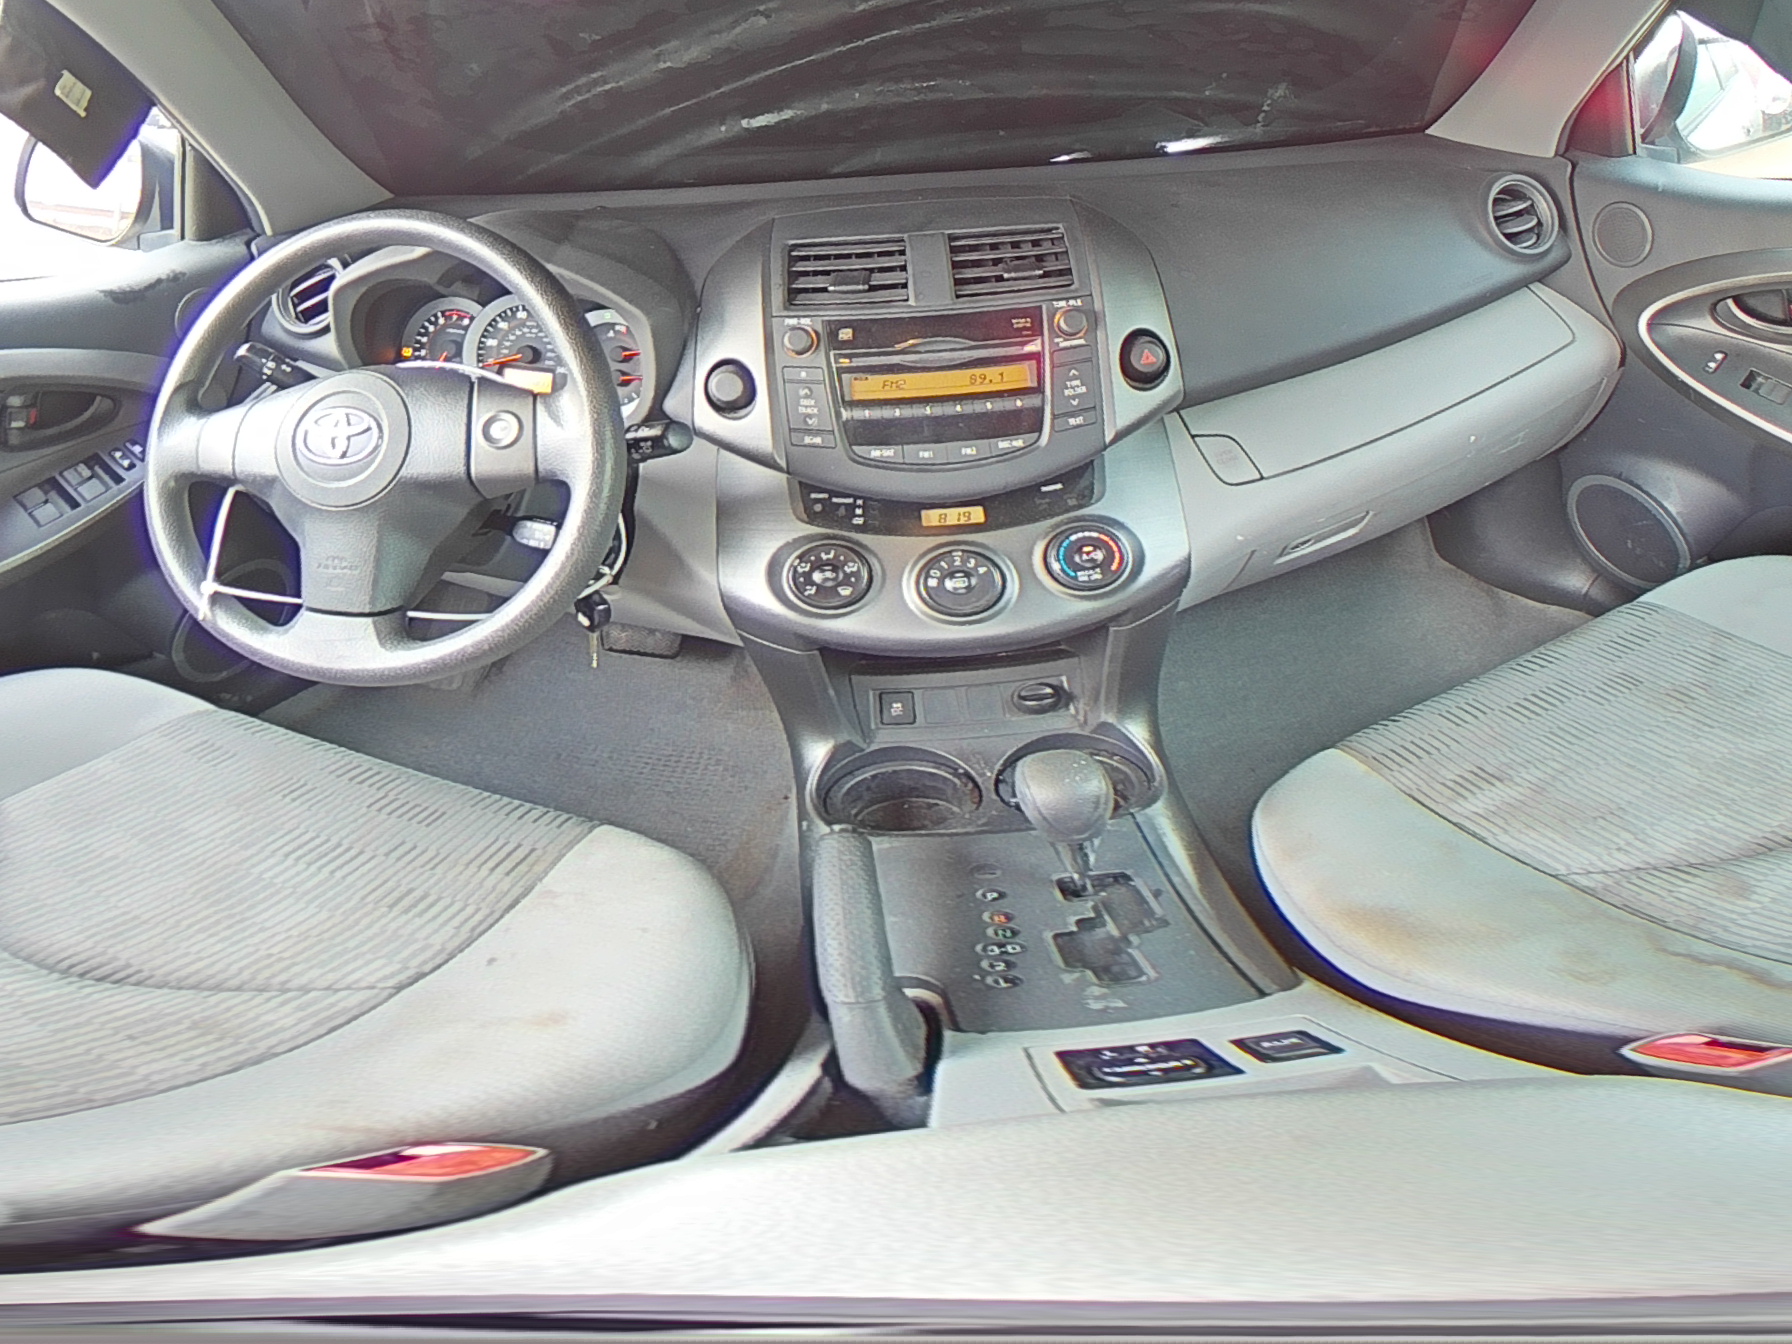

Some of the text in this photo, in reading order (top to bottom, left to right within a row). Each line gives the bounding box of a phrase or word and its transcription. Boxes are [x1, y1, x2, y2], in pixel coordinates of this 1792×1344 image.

[969, 371, 1005, 385] 89.1
[953, 556, 962, 566] 2
[966, 557, 976, 568] 3
